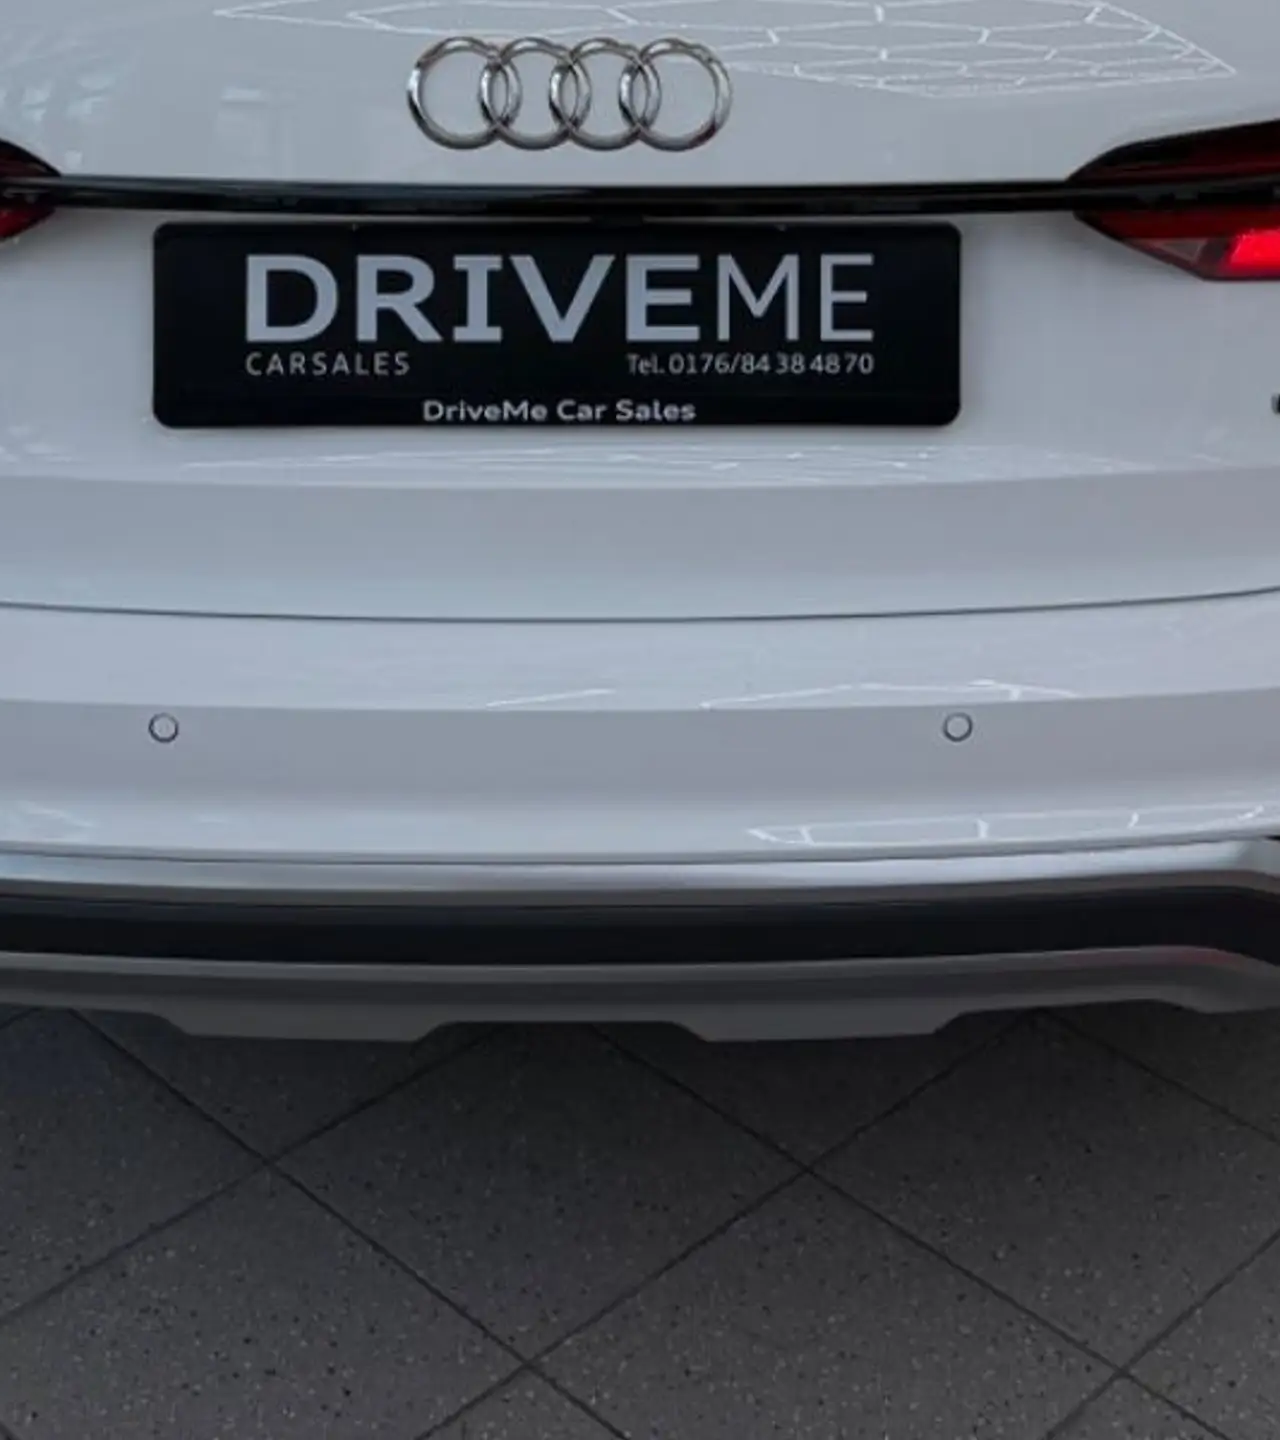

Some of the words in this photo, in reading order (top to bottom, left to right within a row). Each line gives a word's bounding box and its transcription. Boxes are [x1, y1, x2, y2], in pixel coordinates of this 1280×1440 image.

[245, 253, 875, 343] DRIVEME
[244, 350, 412, 376] CARSALES
[422, 399, 548, 422] DriveMe
[556, 399, 608, 422] Car
[614, 399, 697, 422] Sales
